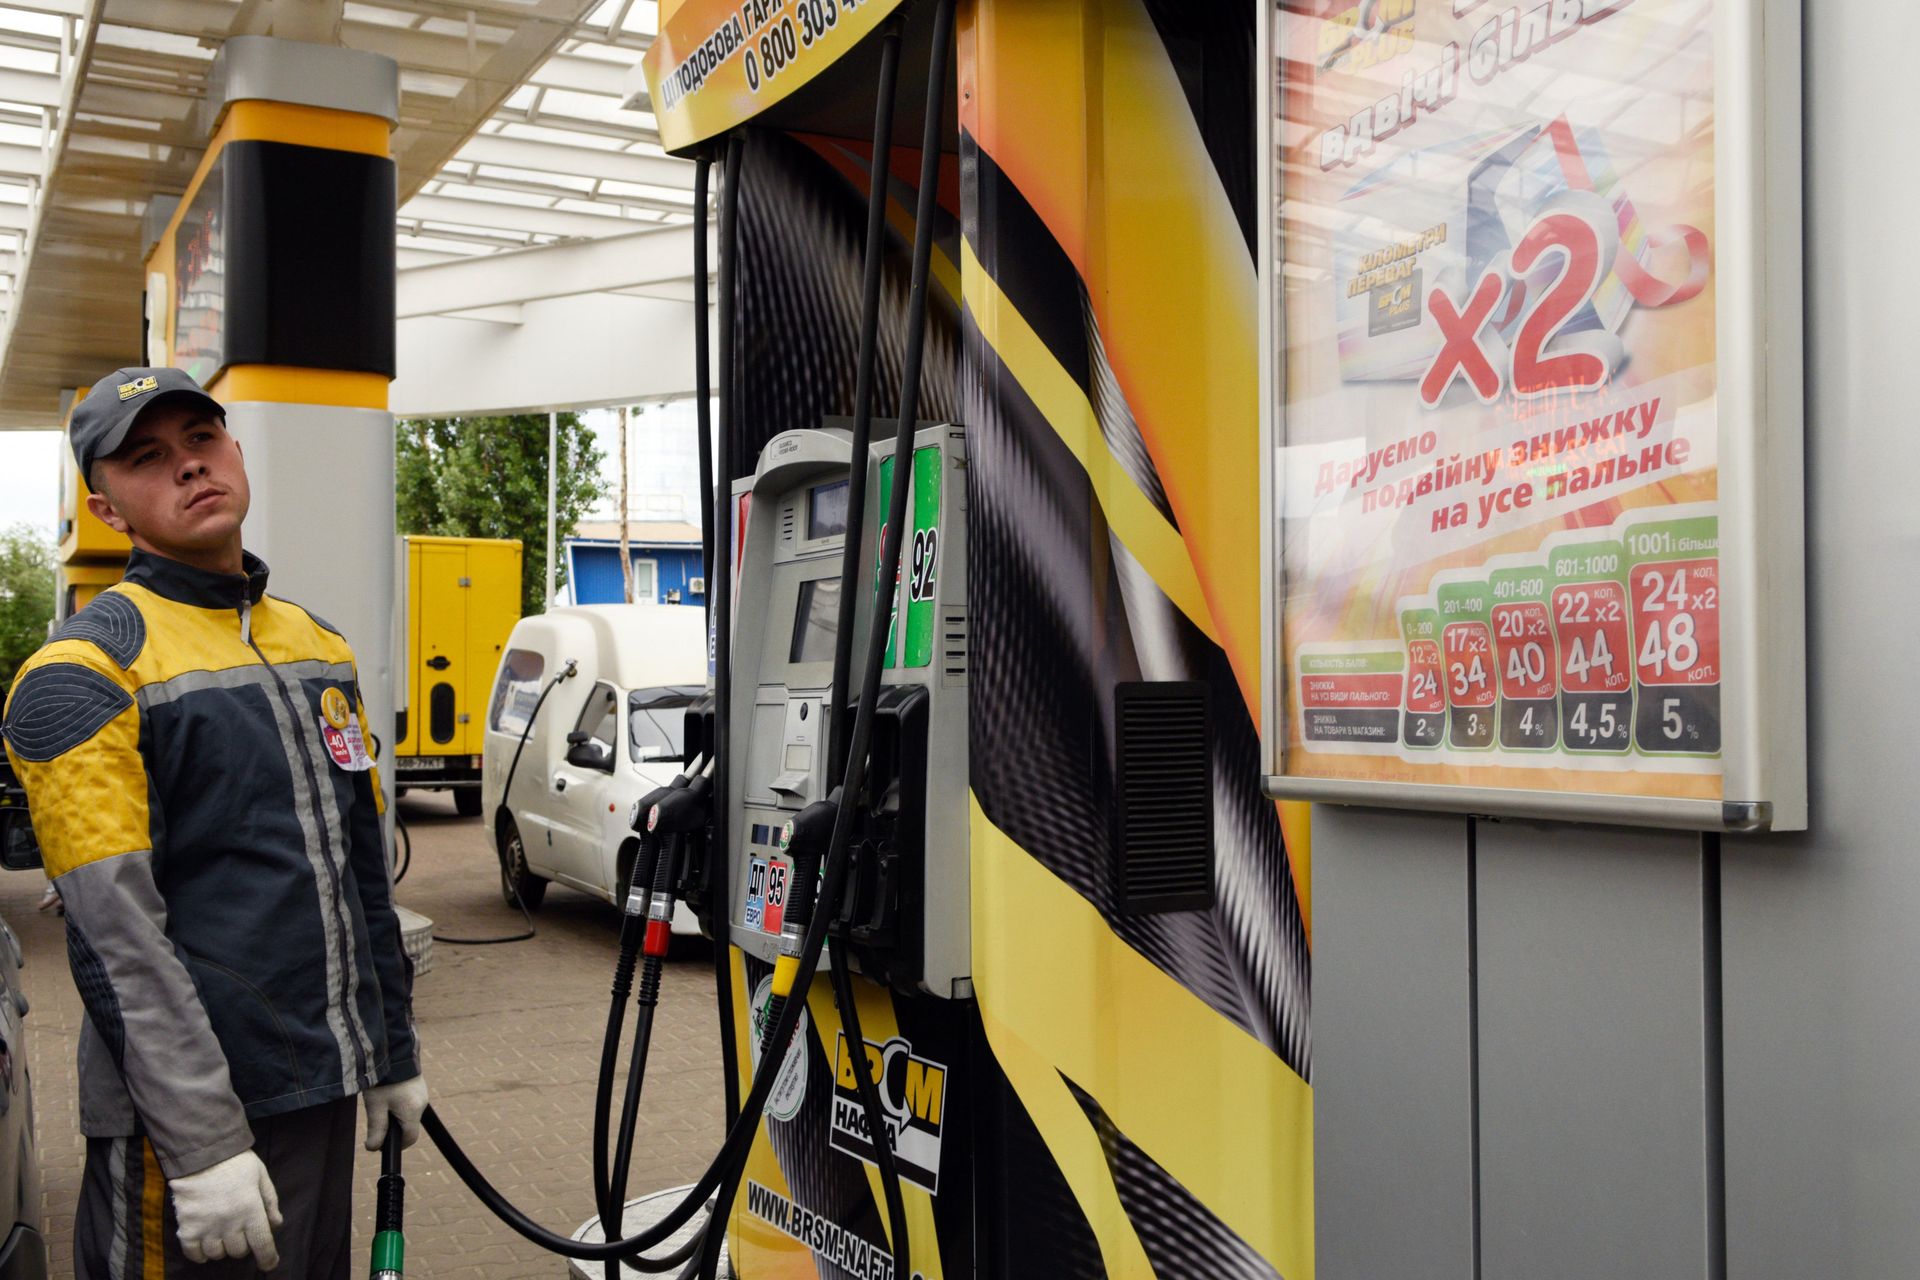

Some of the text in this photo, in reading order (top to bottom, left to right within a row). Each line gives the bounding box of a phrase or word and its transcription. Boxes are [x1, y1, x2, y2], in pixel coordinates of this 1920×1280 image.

[745, 49, 760, 91] 0
[760, 18, 797, 79] 800
[1314, 430, 1437, 497] Даруємо
[1362, 447, 1501, 513] подвійну
[1509, 398, 1661, 467] знижку
[1431, 503, 1469, 533] на
[1478, 482, 1533, 529] усе
[1545, 437, 1691, 502] пальне
[1628, 532, 1670, 556] 1001
[911, 528, 938, 602] 92
[1555, 555, 1618, 577] 601-1000
[1443, 598, 1483, 614] 201-400
[1493, 578, 1544, 598] 401-600
[1558, 591, 1590, 624] 22
[1642, 568, 1689, 612] 24
[1447, 628, 1469, 653] 17
[1498, 609, 1524, 638] 20
[1411, 645, 1425, 664] 12
[1506, 641, 1546, 687] 40
[1565, 628, 1614, 684] 44
[1638, 612, 1698, 677] 48
[1412, 668, 1438, 700] 24
[1450, 654, 1487, 696] 34
[1415, 718, 1427, 738] 2
[1467, 713, 1478, 737] 3
[1519, 706, 1534, 736] 4
[1570, 702, 1617, 744] 4,5
[1662, 698, 1683, 740] 5
[748, 862, 767, 902] ДП
[768, 865, 785, 906] 95
[835, 1100, 898, 1153] НАФА
[748, 1180, 895, 1280] WWW.BRSM-NAFT
